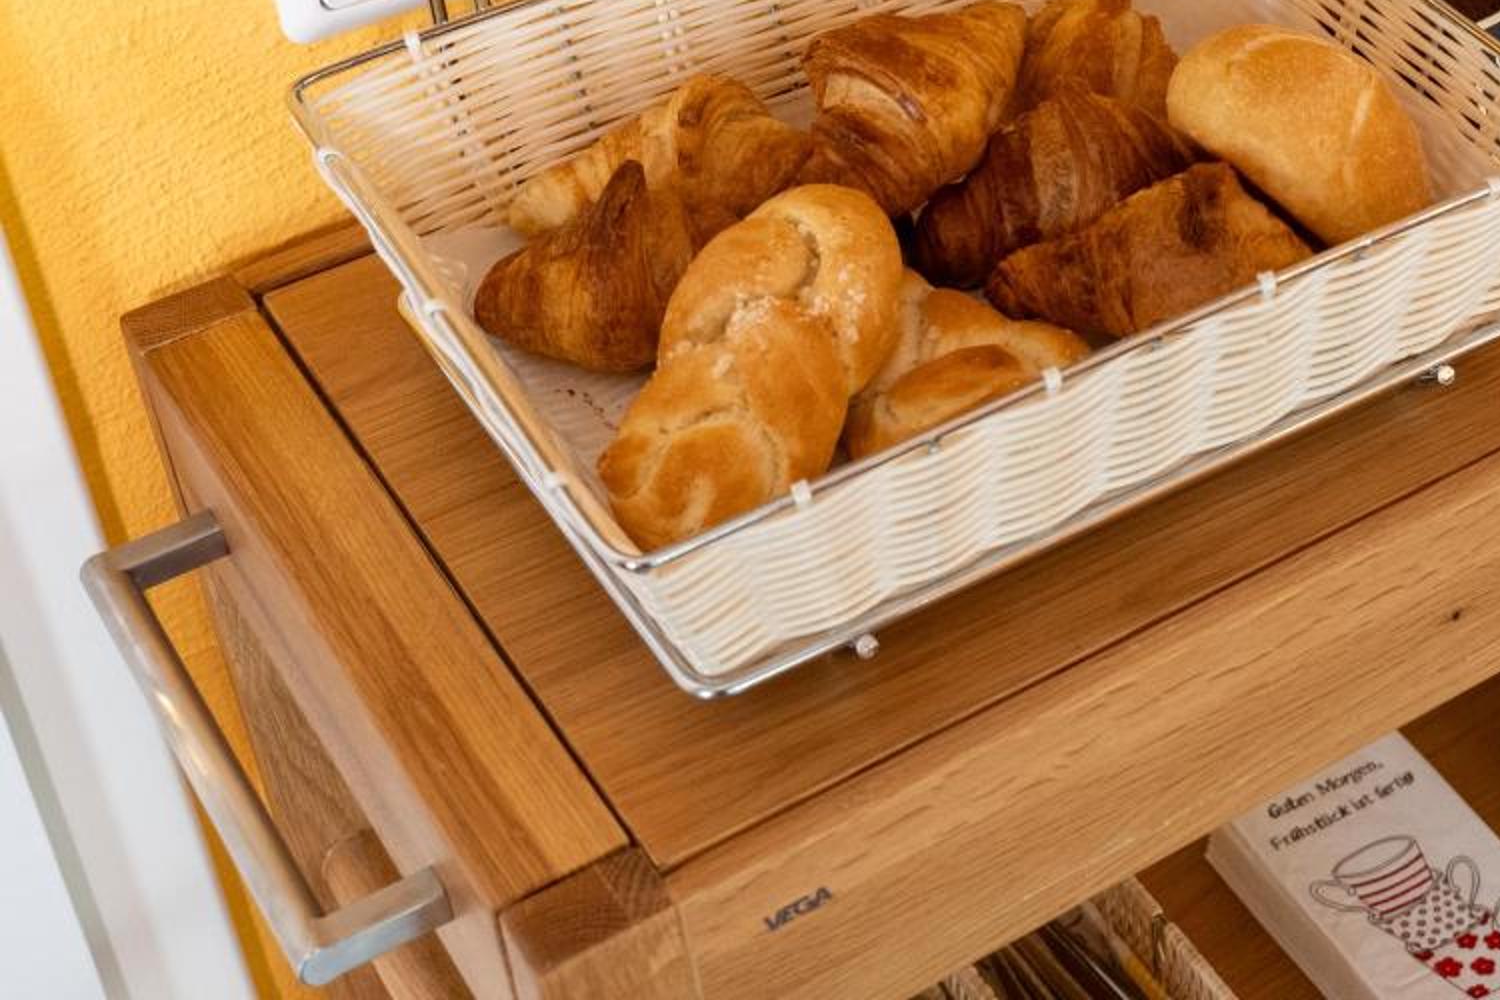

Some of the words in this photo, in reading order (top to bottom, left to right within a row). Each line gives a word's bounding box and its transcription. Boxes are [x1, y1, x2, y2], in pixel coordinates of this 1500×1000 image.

[1267, 795, 1315, 820] Guten
[1270, 805, 1351, 850] Frühstück
[1350, 794, 1375, 812] ist
[763, 886, 832, 931] VEGA
